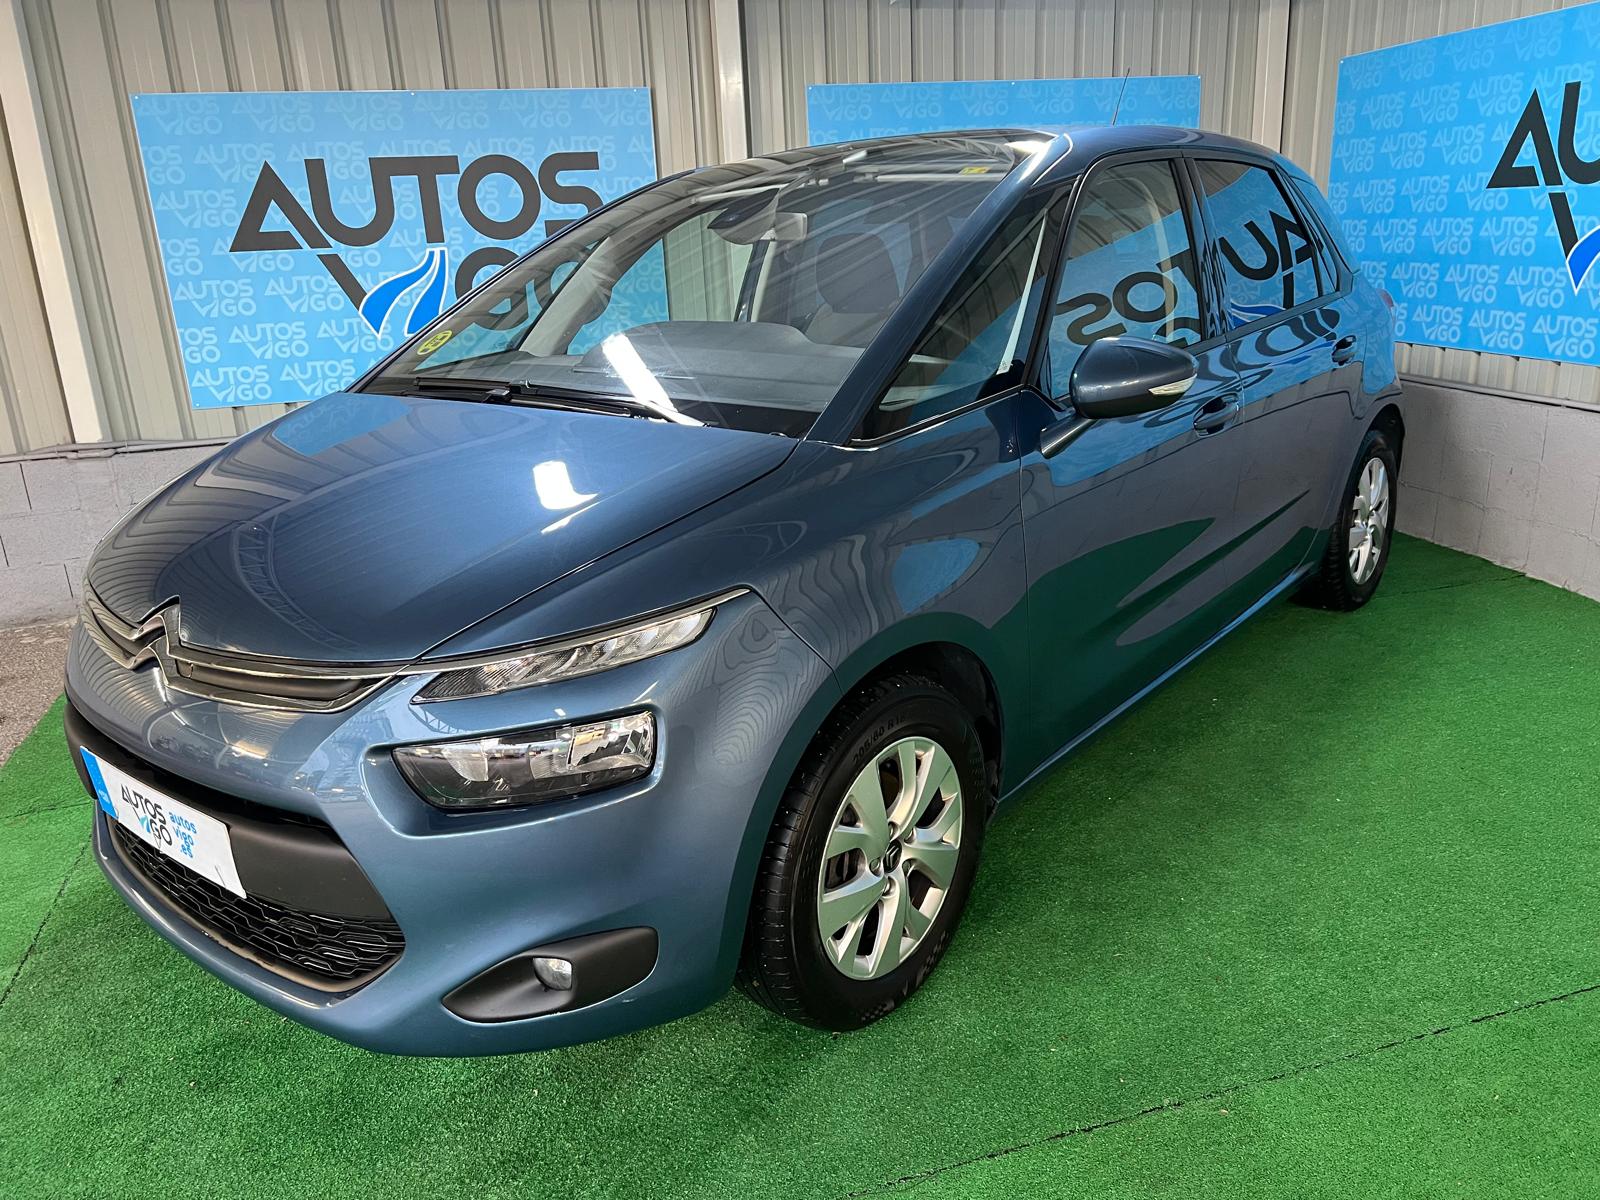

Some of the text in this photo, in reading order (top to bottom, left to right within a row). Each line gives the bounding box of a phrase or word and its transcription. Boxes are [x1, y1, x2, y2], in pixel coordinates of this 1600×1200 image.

[209, 163, 259, 183] VIG
[1400, 174, 1450, 195] AUTOS
[229, 151, 604, 252] AUTOS
[1371, 218, 1418, 237] AUTOS
[1422, 216, 1474, 237] AUTOS
[1479, 215, 1539, 237] AUTOS
[1379, 236, 1415, 254] VIGO
[1431, 235, 1471, 256] VIGO
[1489, 235, 1536, 257] VIGO
[1391, 262, 1440, 280] AUTOS
[1445, 263, 1500, 284] AUTOS
[1504, 265, 1568, 287] AUTOS
[174, 278, 254, 301] AUTOS
[1400, 280, 1438, 299] VIGO
[1455, 282, 1497, 304] VIGO
[1517, 285, 1565, 309] VIGO
[1412, 304, 1464, 326] AUTOS
[1468, 309, 1527, 332] AUTOS
[229, 321, 307, 343] AUTOS
[1422, 322, 1461, 343] VIGO
[1531, 315, 1600, 339] AUTOS
[1479, 327, 1524, 350] VIGO
[1544, 334, 1596, 359] VIGO
[244, 341, 310, 359] VIGO
[191, 364, 270, 387] AUTOS
[279, 358, 356, 381] AUTOS
[207, 382, 273, 402] VIGO
[121, 783, 167, 825] AUTOS
[168, 811, 198, 834] autos
[172, 825, 194, 849] vigo
